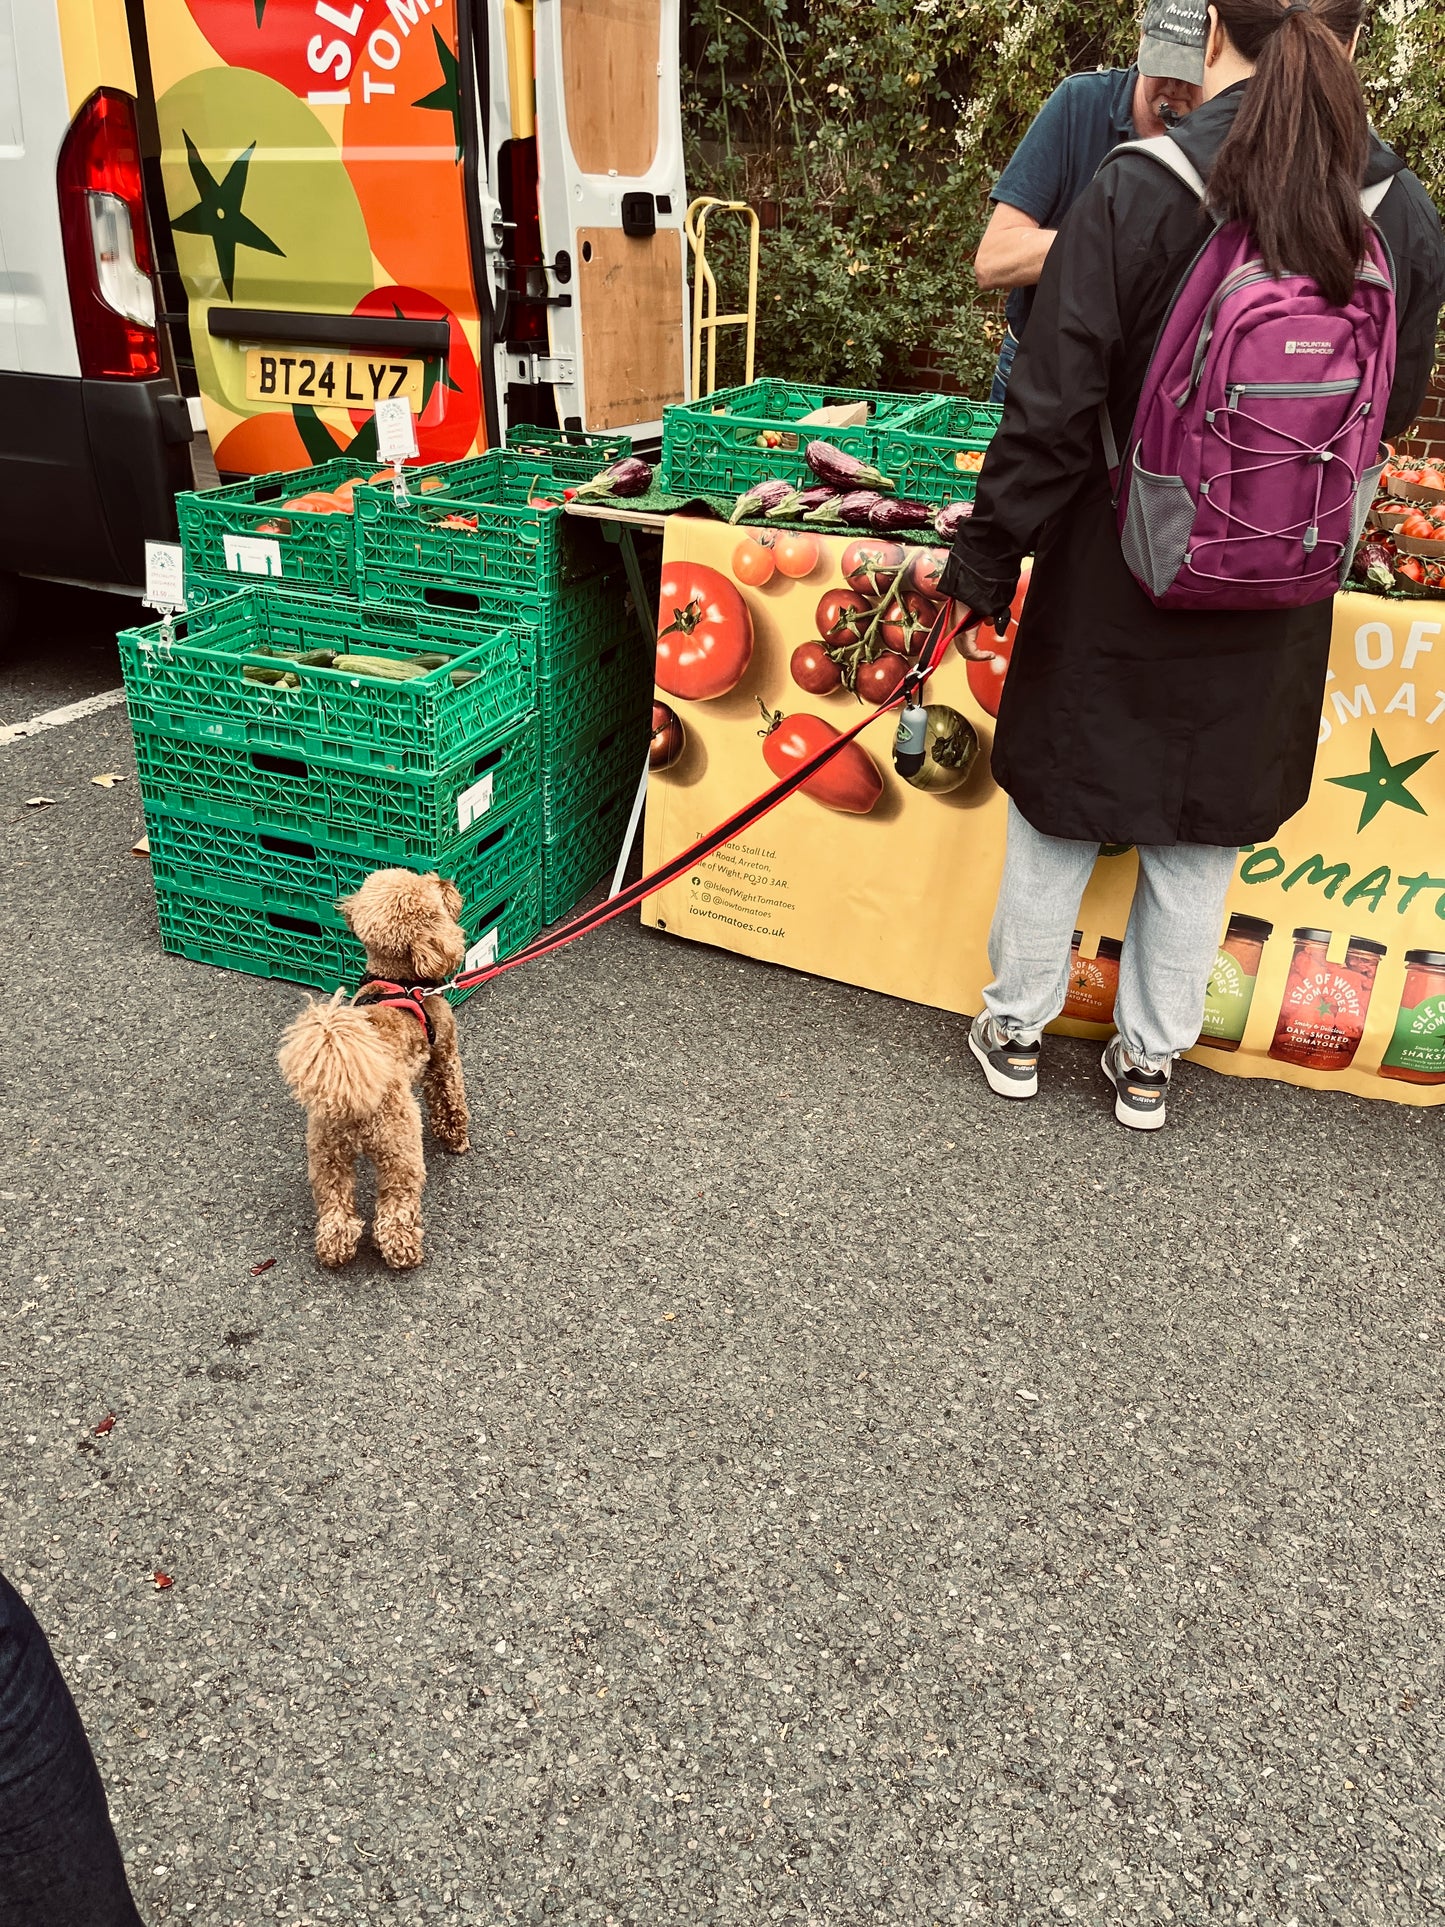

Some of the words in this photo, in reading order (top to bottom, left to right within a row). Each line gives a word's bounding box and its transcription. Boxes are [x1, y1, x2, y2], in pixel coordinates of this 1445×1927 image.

[307, 0, 369, 105] ISL
[363, 0, 443, 104] TOM
[259, 356, 336, 399] BT24
[345, 362, 408, 401] LYZ
[1354, 621, 1442, 670] OF
[715, 851, 738, 865] Road,
[738, 858, 772, 872] Arreton,
[741, 844, 761, 857] Stall
[761, 847, 777, 859] Ltd.
[707, 862, 718, 872] of
[717, 865, 743, 880] Wight,
[1239, 845, 1445, 921] OMAT
[689, 905, 786, 938] iowtomatoes.co.uk
[712, 896, 772, 919] @iowtomatoes
[1076, 961, 1087, 969] OF
[1088, 963, 1105, 989] WIGHT
[1214, 954, 1240, 997] WIGHT
[1290, 978, 1313, 1005] ISLE
[1315, 973, 1331, 985] OF
[1333, 975, 1360, 1017] WIGHT
[1302, 986, 1347, 1013] TOMATOES
[1293, 1019, 1312, 1030] Smoky
[1320, 1025, 1346, 1035] Delicious
[1410, 1006, 1436, 1034] ISLE
[1286, 1026, 1349, 1043] OAK-SMOKED
[1290, 1035, 1340, 1049] TOMATOES
